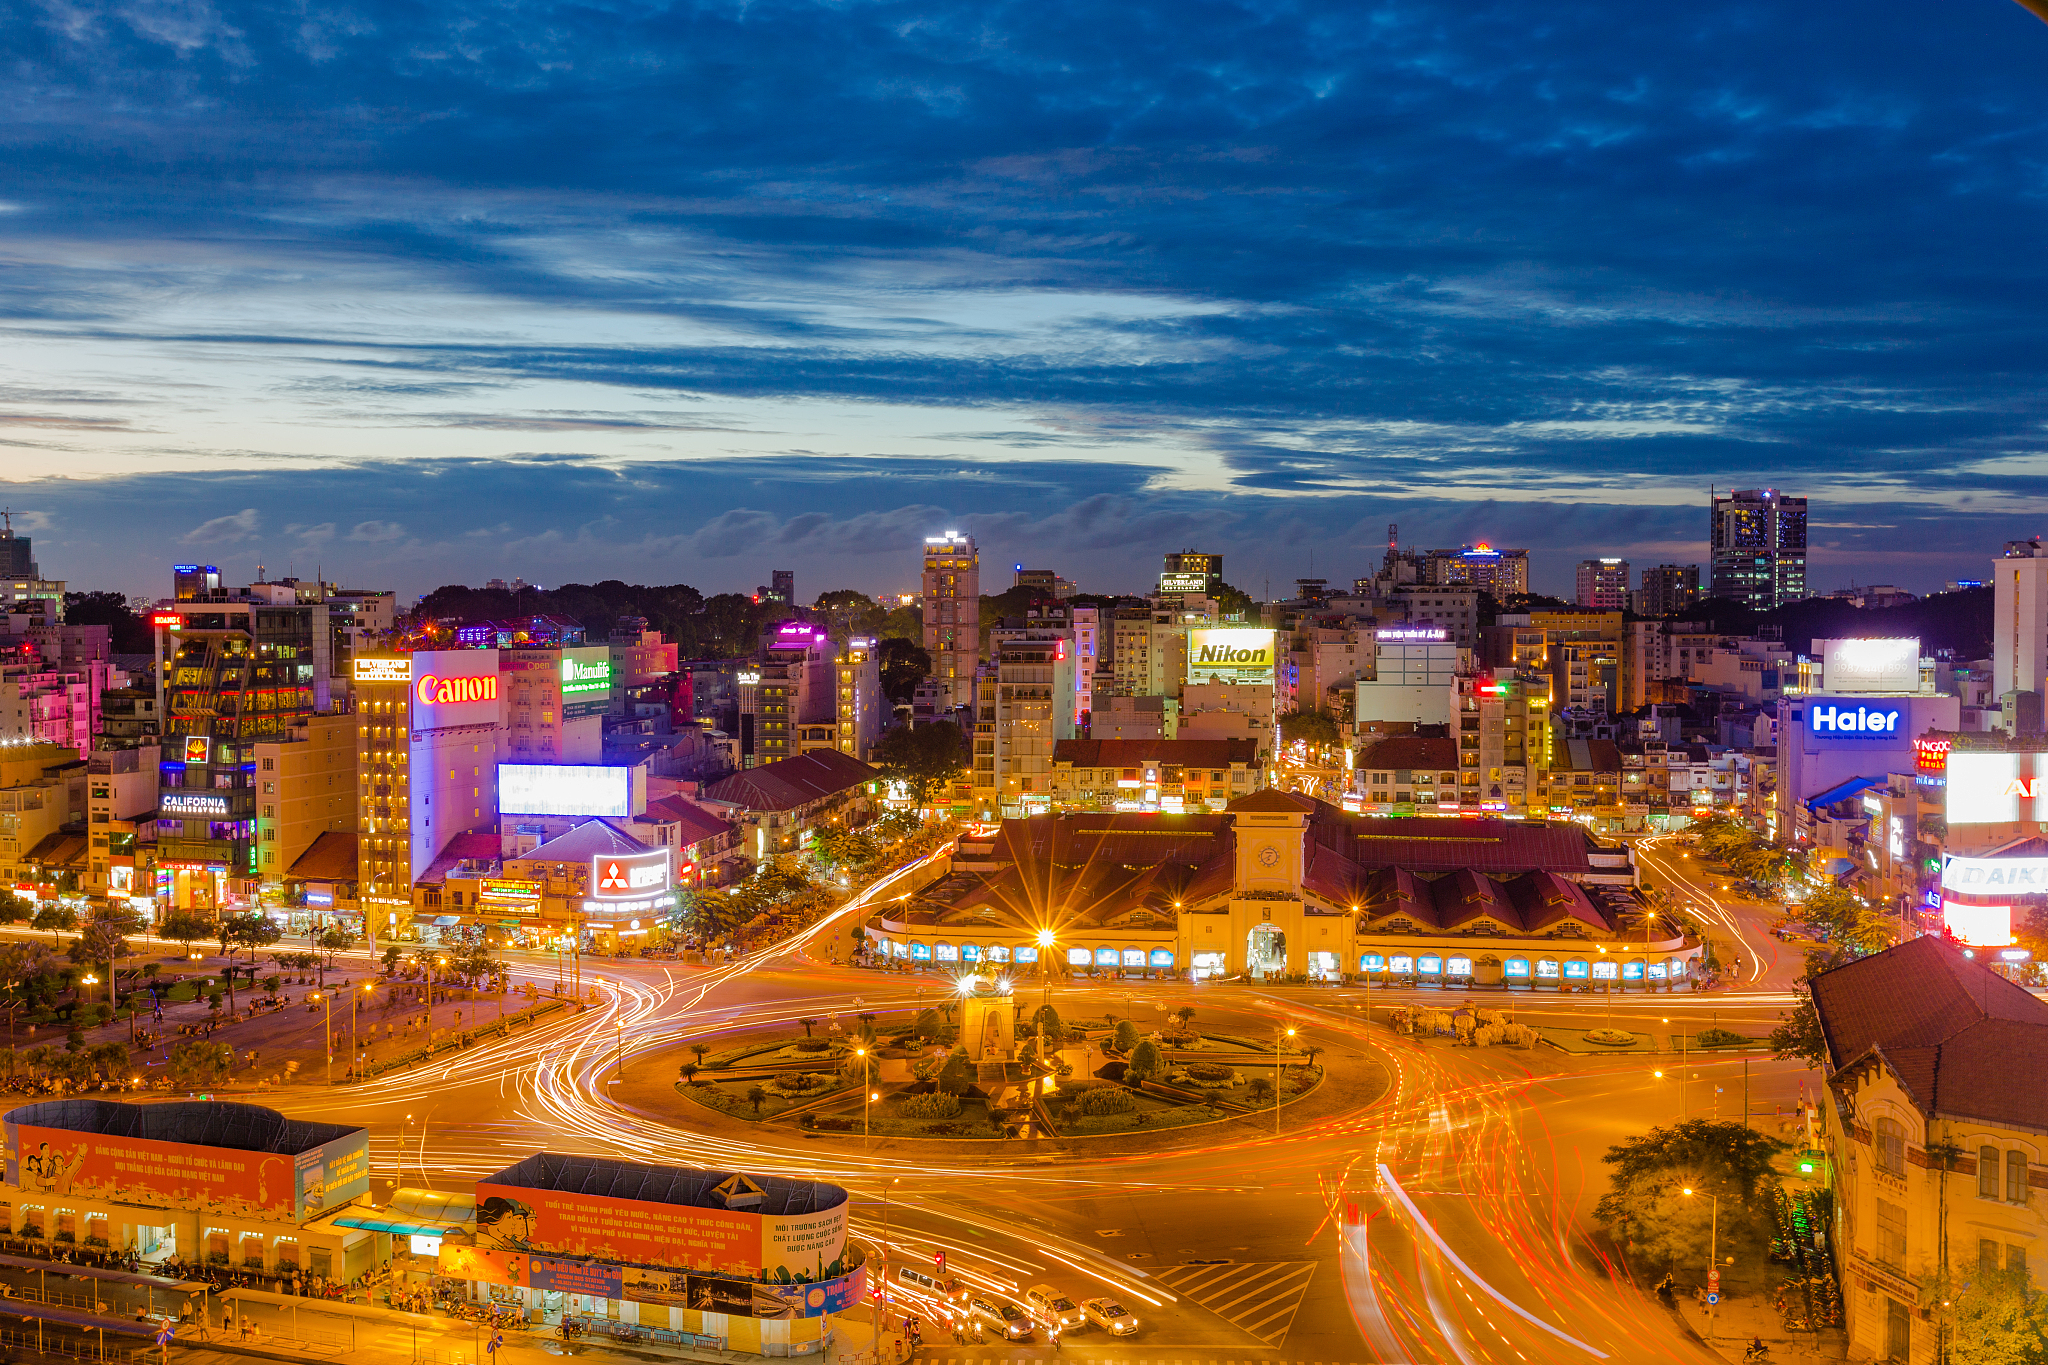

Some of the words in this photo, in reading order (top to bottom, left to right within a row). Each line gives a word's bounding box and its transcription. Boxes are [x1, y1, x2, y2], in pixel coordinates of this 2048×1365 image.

[1198, 644, 1267, 662] Nikon
[527, 661, 550, 671] Open
[573, 661, 610, 680] Manulife
[1887, 663, 1908, 673] 899
[417, 674, 497, 705] Canon
[1813, 706, 1899, 731] Haier
[163, 796, 226, 807] CALIFORNIA
[95, 1144, 110, 1156] ĐẢNG
[110, 1147, 125, 1159] CỘNG
[125, 1147, 137, 1159] SẢN
[137, 1150, 150, 1162] VIỆT
[150, 1153, 163, 1163] NAM
[185, 1154, 193, 1166] TỔ
[193, 1156, 209, 1168] CHỨC
[209, 1158, 217, 1169] VÀ
[217, 1159, 233, 1171] LÃNH
[233, 1162, 245, 1173] ĐẠO
[114, 1161, 126, 1173] MỌI
[126, 1161, 144, 1173] THẮNG
[144, 1164, 154, 1176] LỢI
[154, 1164, 166, 1176] CỦA
[166, 1166, 181, 1178] CÁCH
[181, 1169, 198, 1181] MẠNG
[198, 1170, 211, 1183] VIỆT
[211, 1173, 225, 1183] NAM
[545, 1200, 560, 1209] TUỔI
[562, 1202, 575, 1211] TRẺ
[576, 1204, 598, 1213] THÀNH
[599, 1206, 614, 1215] PHỐ
[614, 1208, 629, 1217] YÊU
[652, 1212, 672, 1222] NÂNG
[673, 1215, 687, 1224] CAO
[696, 1217, 714, 1227] THỨC
[715, 1220, 735, 1229] CÔNG
[735, 1222, 753, 1232] DÂN,
[775, 1223, 789, 1232] MÔI
[790, 1221, 817, 1231] TRƯỜNG
[818, 1217, 833, 1229] SẠCH
[833, 1213, 842, 1224] ĐẸP
[559, 1213, 576, 1222] TRAU
[590, 1216, 599, 1224] LÝ
[624, 1220, 642, 1229] CÁCH
[643, 1223, 666, 1233] MẠNG,
[667, 1225, 682, 1234] RÈN
[683, 1227, 700, 1237] ĐỨC,
[701, 1229, 725, 1240] LUYỆN
[726, 1232, 739, 1241] TÀI
[773, 1233, 791, 1242] CHẤT
[792, 1232, 815, 1243] LƯỢNG
[815, 1228, 831, 1239] CUỘC
[831, 1223, 843, 1234] SỐNG
[579, 1226, 601, 1235] THÀNH
[602, 1228, 616, 1237] PHỐ
[617, 1230, 632, 1239] VĂN
[632, 1232, 652, 1242] MINH,
[653, 1235, 671, 1244] HIỆN
[672, 1237, 686, 1247] ĐẠI,
[688, 1239, 708, 1248] NGHĨA
[710, 1241, 726, 1250] TÌNH
[786, 1243, 805, 1254] ĐƯỢC
[806, 1241, 824, 1251] NÂNG
[825, 1237, 836, 1247] CAO
[543, 1261, 557, 1273] TRẠM
[556, 1260, 569, 1273] ĐIỀU
[582, 1266, 589, 1276] XE
[589, 1266, 603, 1278] BUÝT
[611, 1268, 622, 1280] GÒN
[584, 1277, 606, 1285] STATION
[826, 1282, 844, 1297] TRẠM
